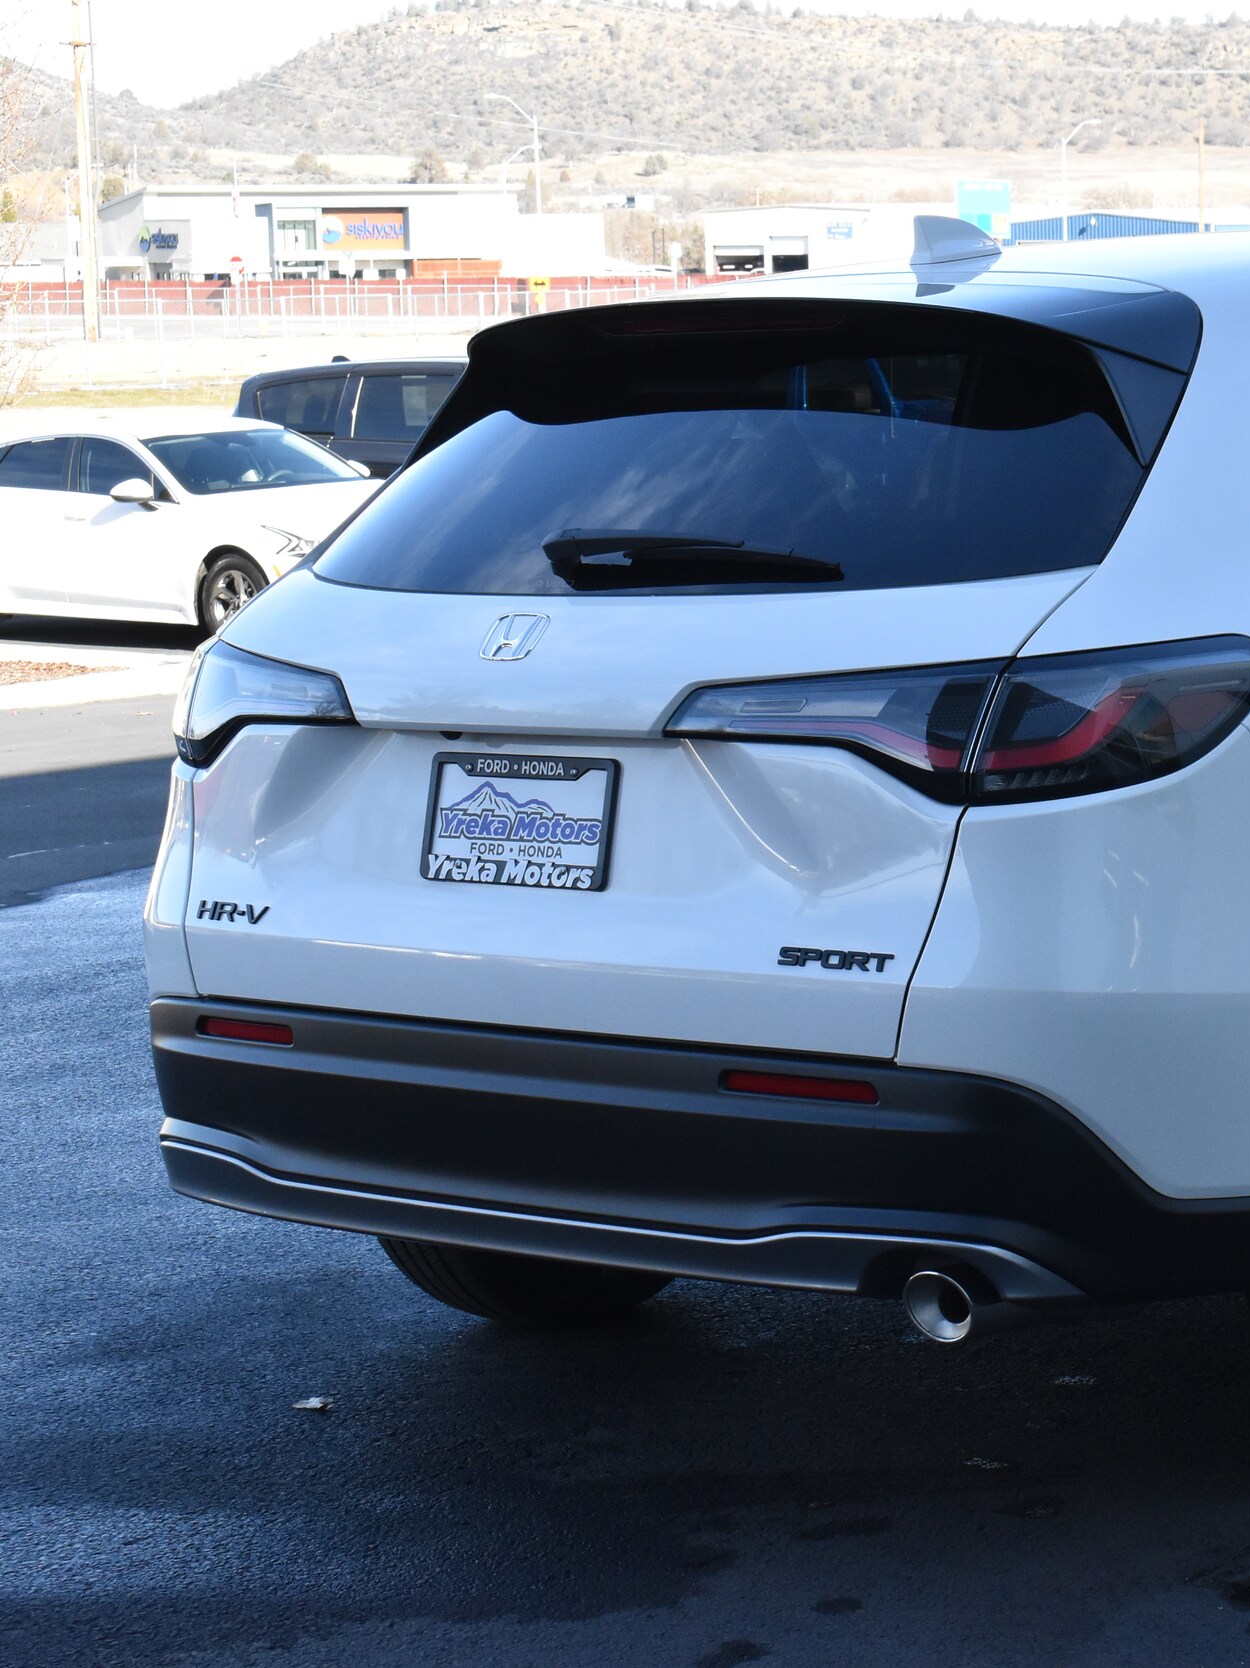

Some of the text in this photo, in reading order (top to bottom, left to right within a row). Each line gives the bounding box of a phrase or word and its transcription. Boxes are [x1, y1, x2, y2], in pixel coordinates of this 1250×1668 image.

[476, 759, 564, 776] FORD HONDA
[439, 809, 602, 844] Yreka Motors
[470, 842, 563, 859] FORD HONDA
[427, 854, 594, 889] Yreka Motors
[196, 899, 271, 925] HR-V
[777, 946, 895, 973] SPORT
